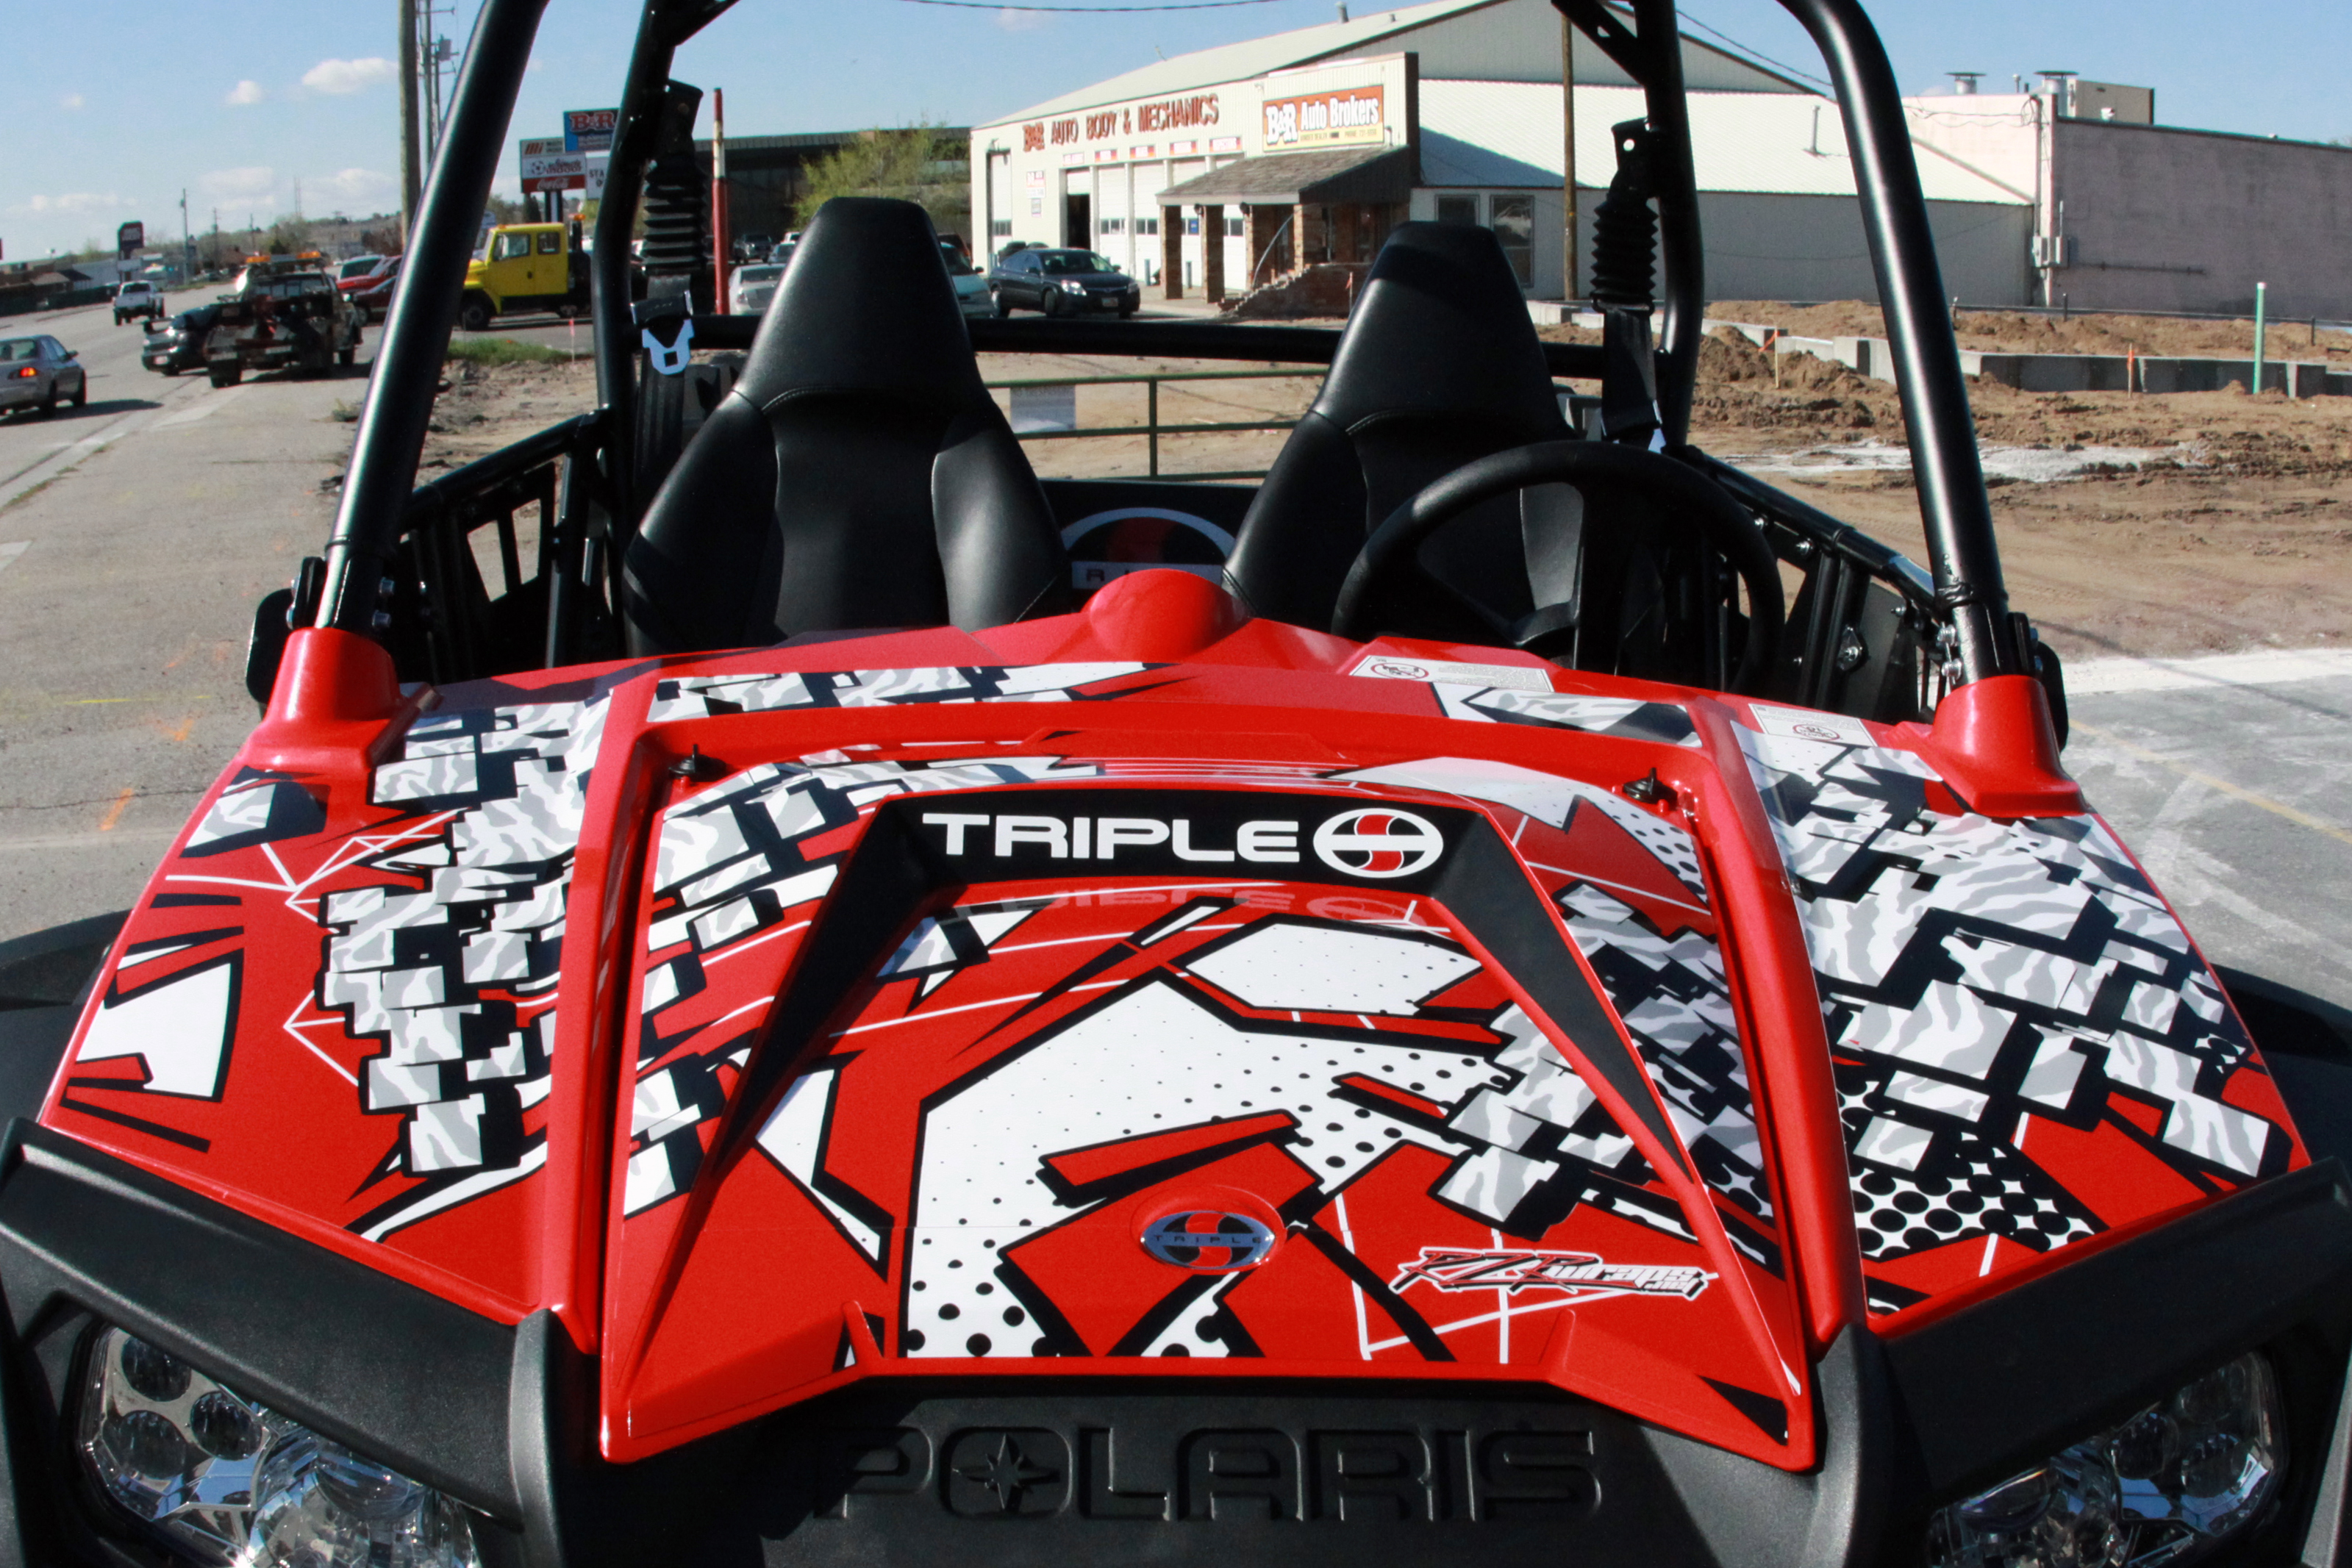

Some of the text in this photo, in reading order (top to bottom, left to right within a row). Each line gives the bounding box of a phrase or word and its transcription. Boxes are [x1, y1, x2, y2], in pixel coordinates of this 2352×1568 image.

[570, 112, 615, 132] B&R
[1051, 118, 1079, 146] AUTO
[1086, 110, 1117, 141] BODY
[1123, 107, 1132, 135] &
[1138, 93, 1219, 134] MECHANICS
[1266, 103, 1298, 145] B&R
[1301, 101, 1327, 131] Auto
[1329, 94, 1379, 128] Brokers
[922, 813, 1301, 862] TRIPLE
[1153, 1235, 1262, 1244] TRIPLE
[812, 1426, 1604, 1521] POLARIS
